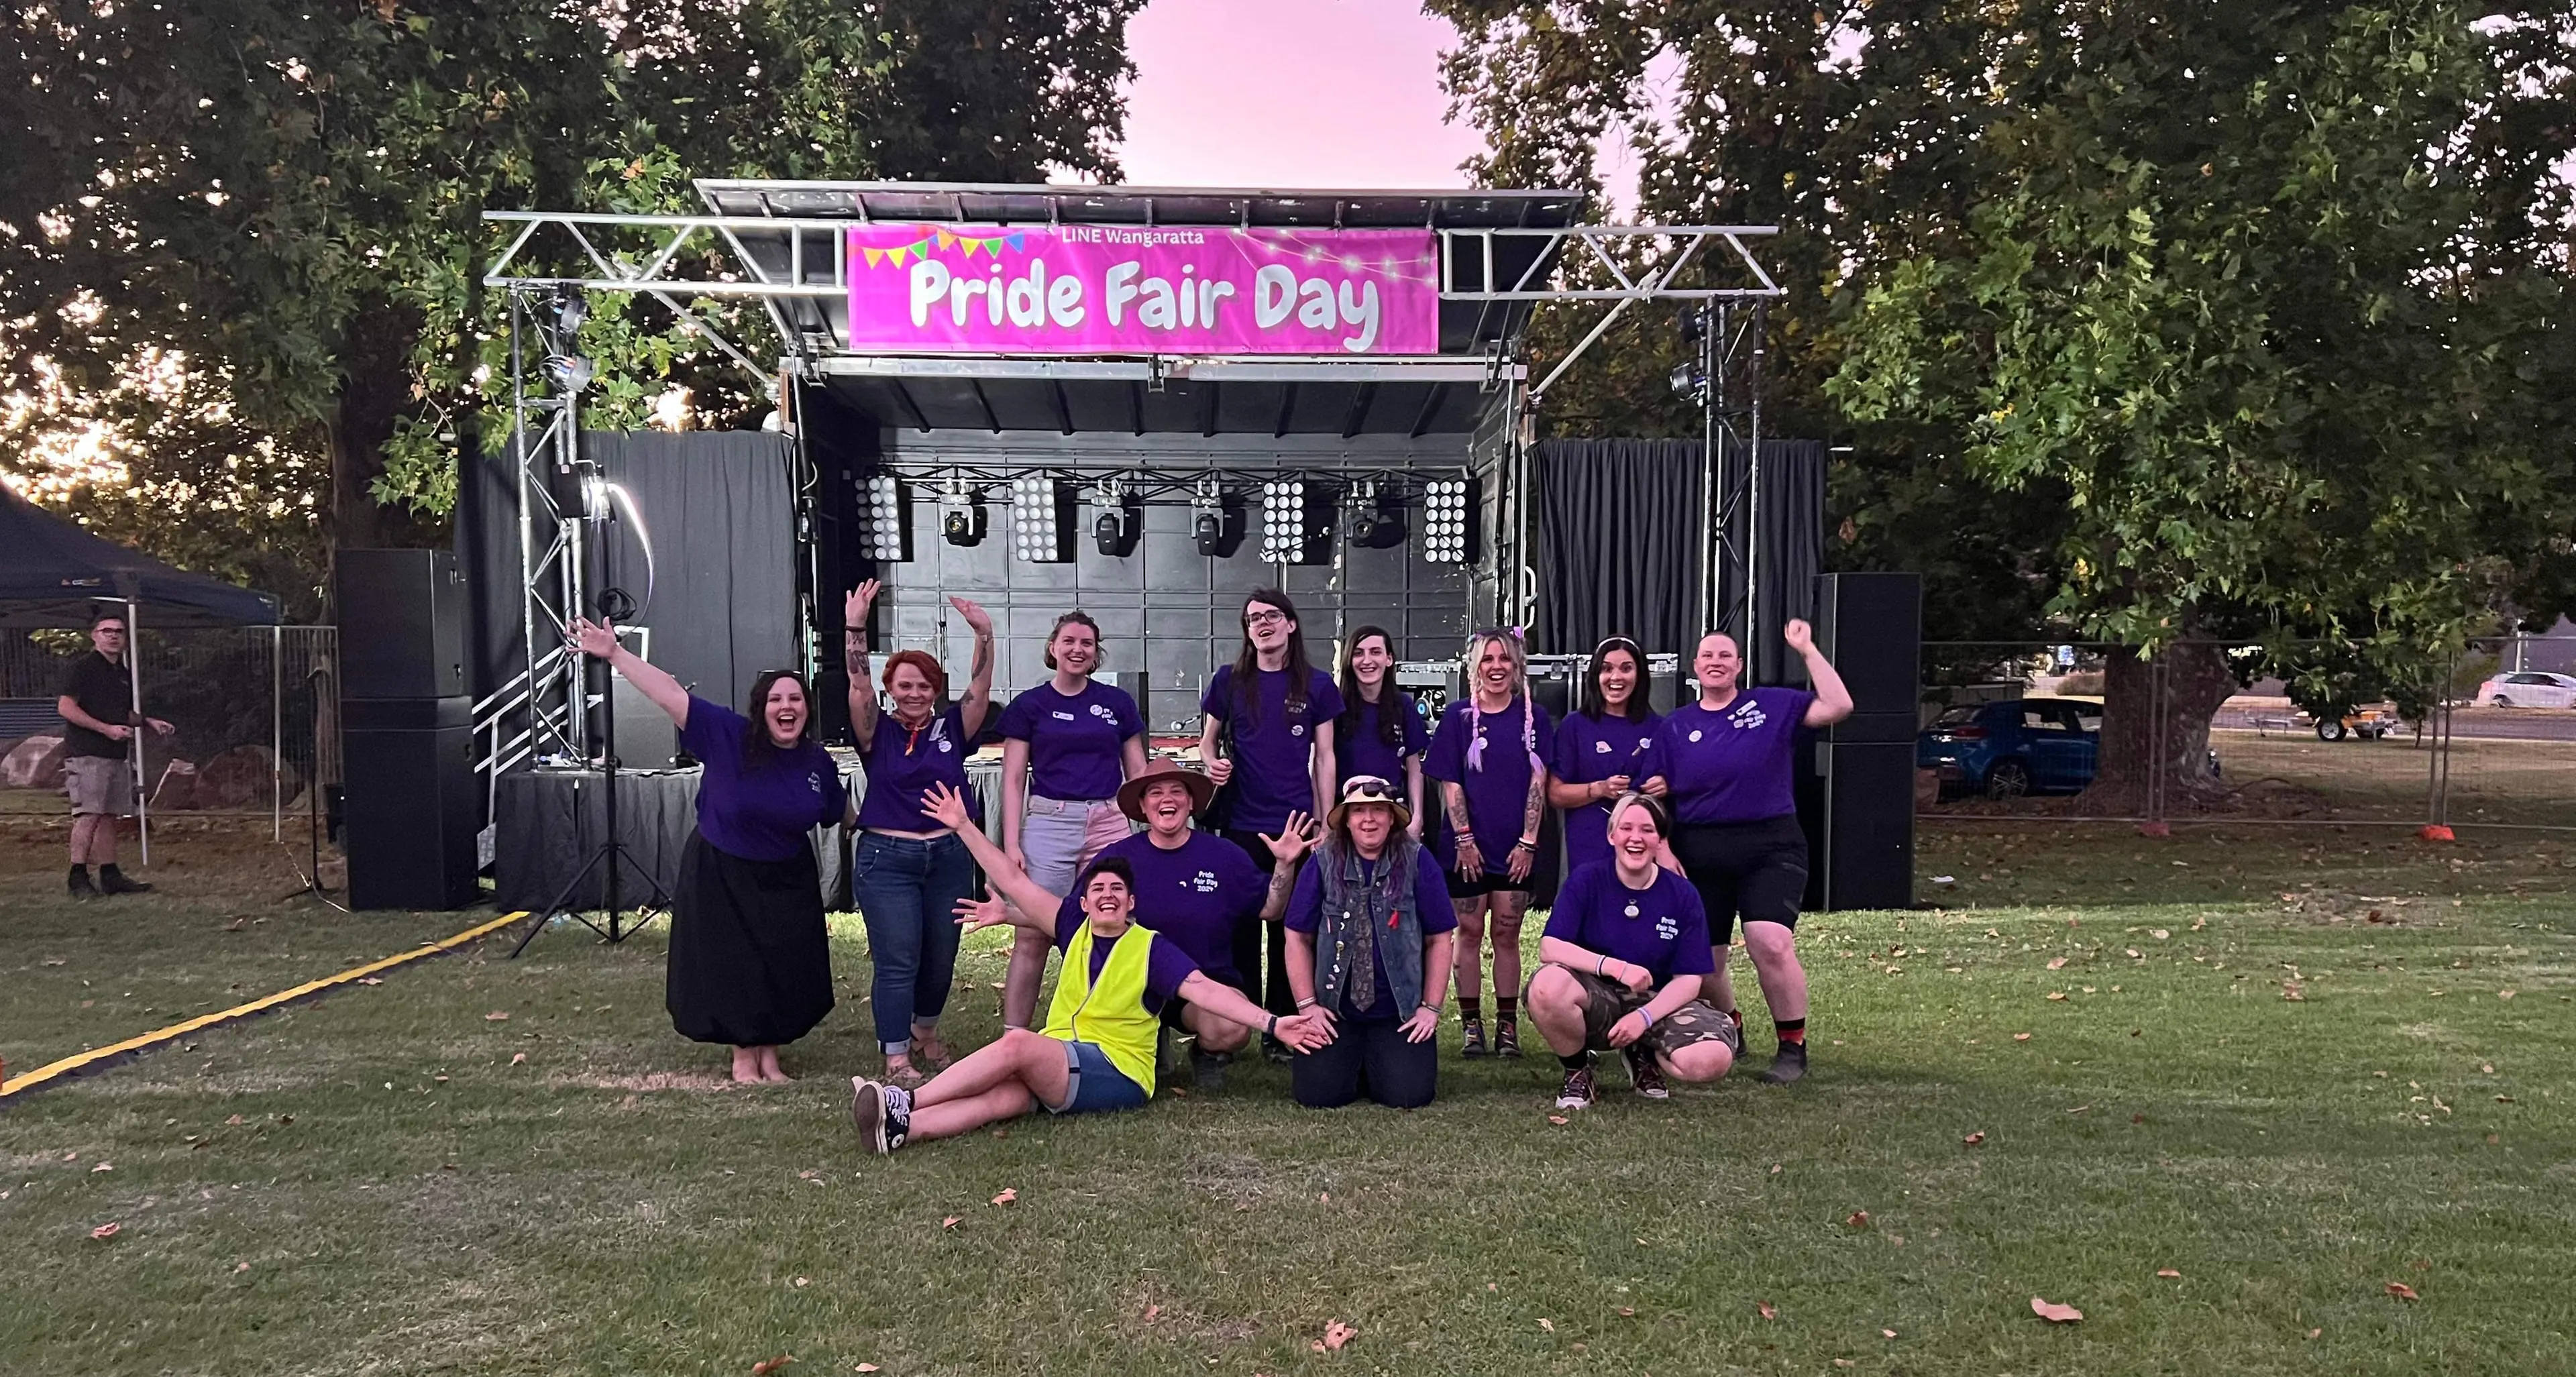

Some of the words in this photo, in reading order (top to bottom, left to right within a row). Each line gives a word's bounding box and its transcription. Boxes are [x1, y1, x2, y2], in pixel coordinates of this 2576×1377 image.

[1061, 228, 1102, 243] LINE
[1105, 229, 1205, 247] Wangaratta
[910, 258, 1085, 328] Pride
[1106, 260, 1235, 330] Fair
[1254, 264, 1379, 353] Day
